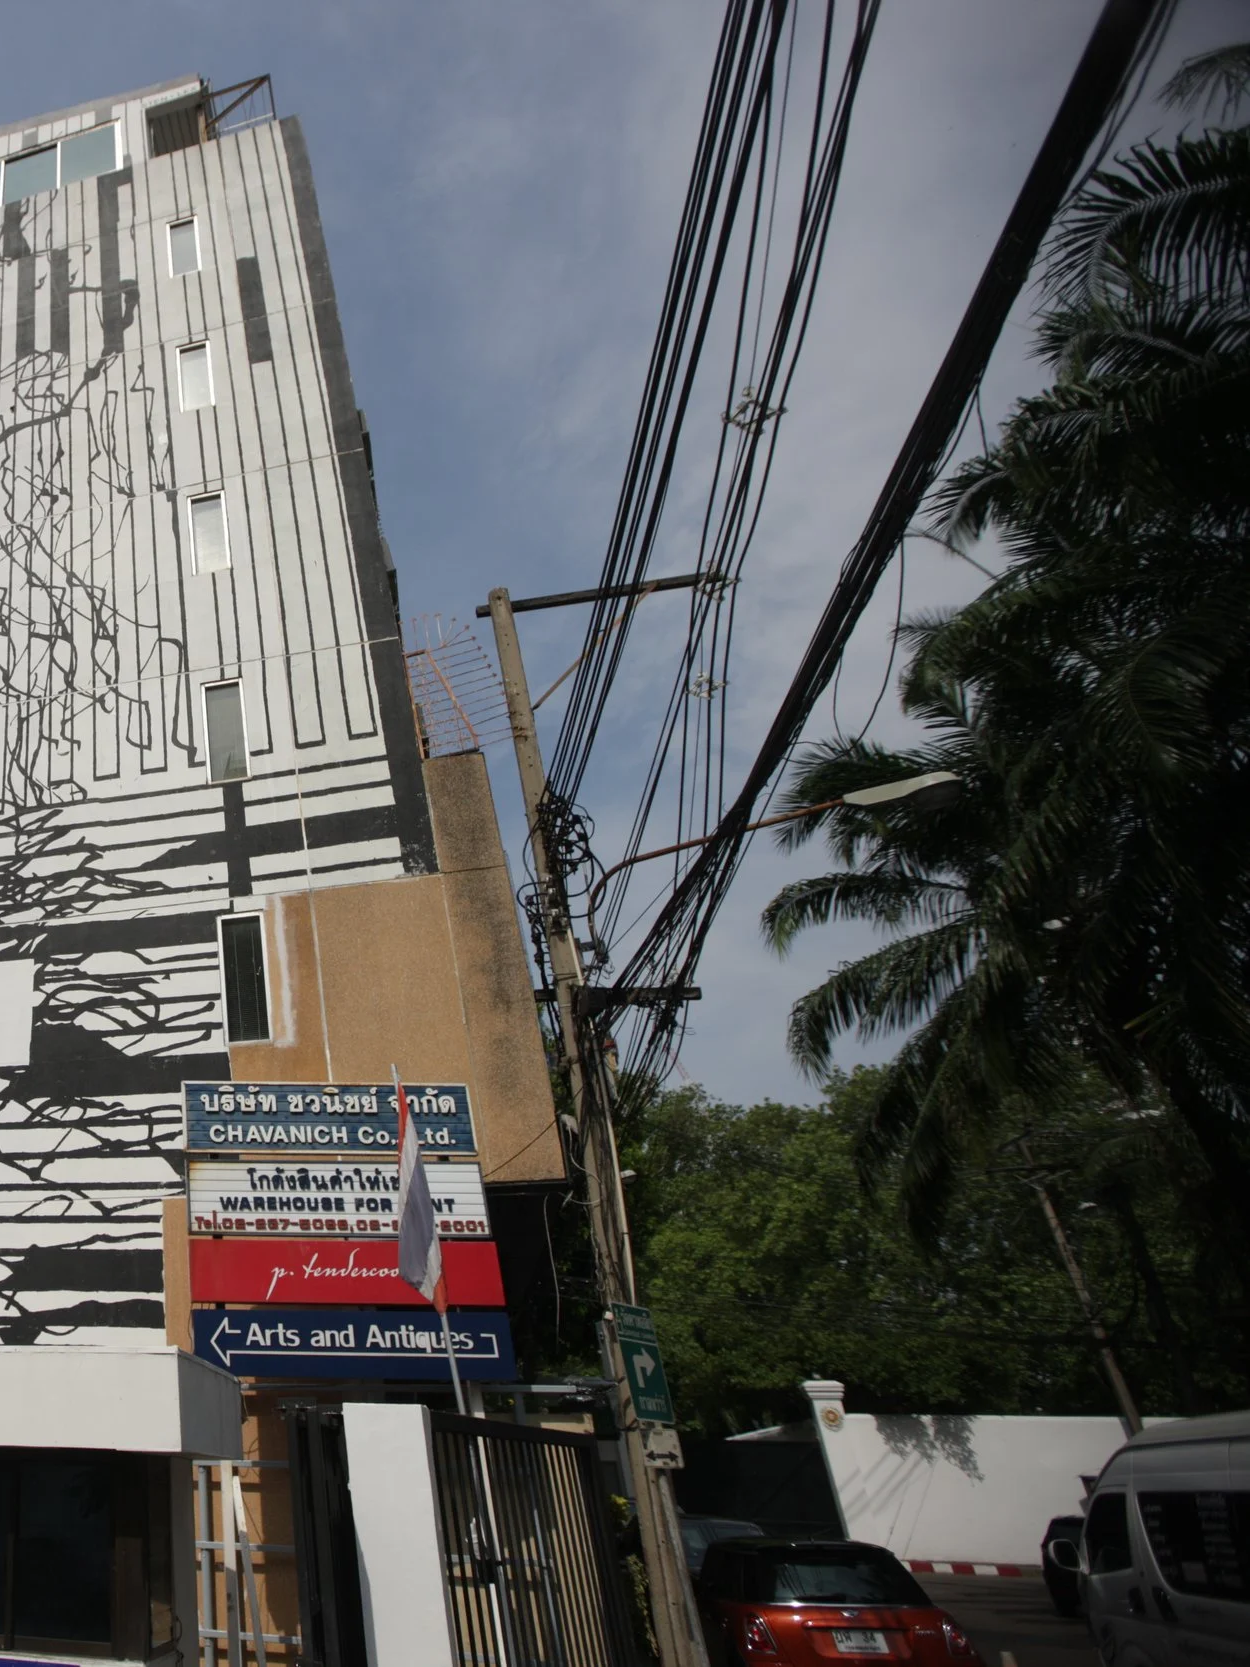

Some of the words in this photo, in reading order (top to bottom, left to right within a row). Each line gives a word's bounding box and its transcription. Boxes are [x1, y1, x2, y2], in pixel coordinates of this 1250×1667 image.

[200, 1086, 277, 1113] บริษัท
[287, 1086, 377, 1114] ชวนิชย์
[209, 1125, 348, 1145] CHAVANICH
[418, 1126, 457, 1146] td.
[246, 1167, 401, 1193] โกดังสินค้าให้เช
[219, 1196, 346, 1213] WAREHOUSE
[354, 1197, 393, 1213] FOR
[266, 1266, 295, 1300] p.
[302, 1248, 400, 1280] tendercoo
[246, 1323, 300, 1347] Arts
[310, 1325, 355, 1348] and
[365, 1324, 474, 1353] Antiques
